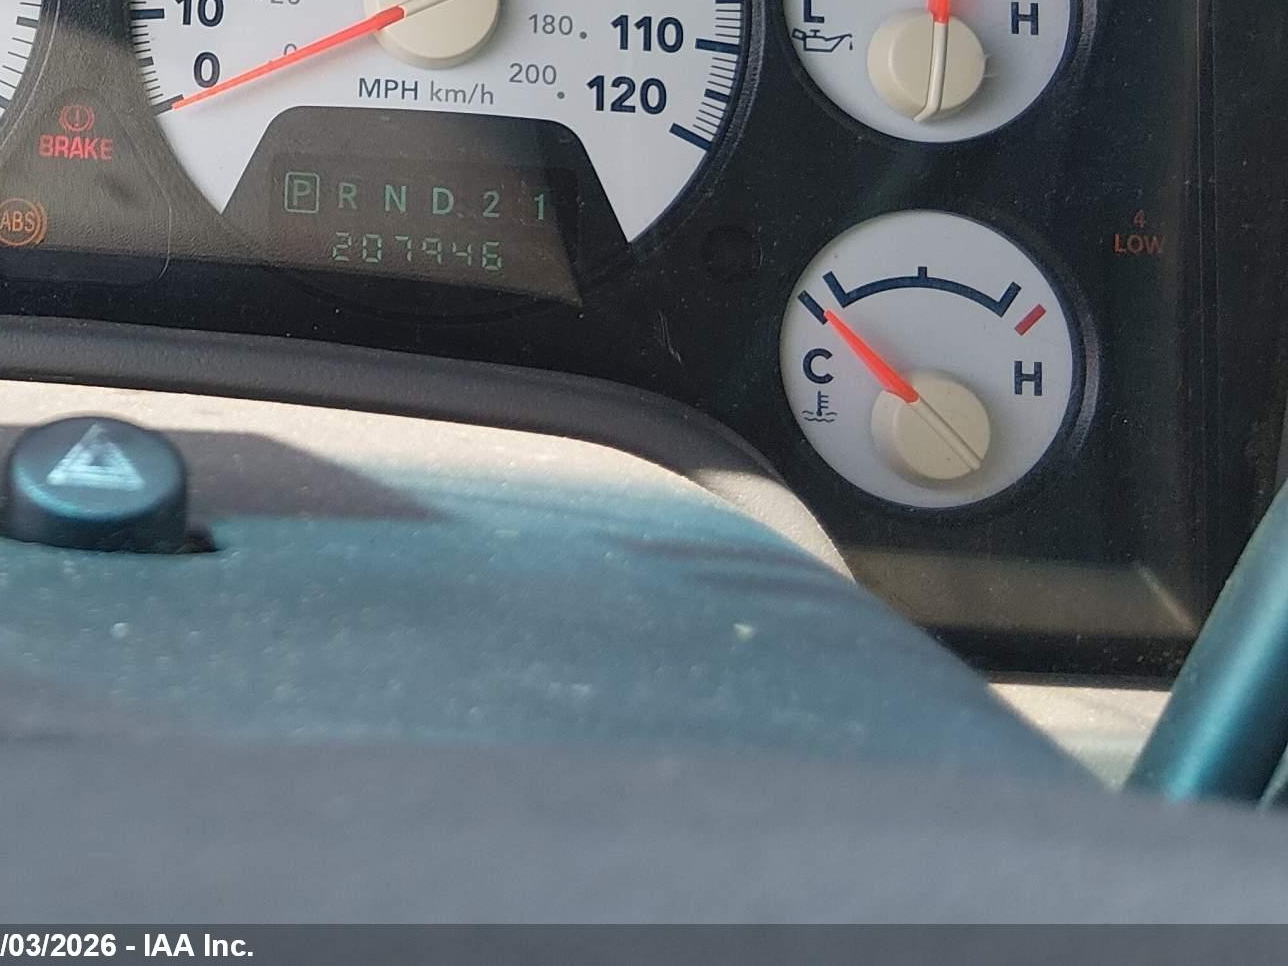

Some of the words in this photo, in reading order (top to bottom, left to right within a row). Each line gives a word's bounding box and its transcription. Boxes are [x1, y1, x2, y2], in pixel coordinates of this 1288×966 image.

[528, 13, 573, 36] 180
[610, 14, 684, 54] 110
[1010, 1, 1039, 36] H
[193, 51, 221, 89] 0
[509, 62, 557, 86] 200
[358, 77, 419, 101] MPH
[428, 80, 495, 107] km/h
[586, 74, 667, 115] 120
[39, 134, 113, 161] BRAKE
[291, 179, 312, 206] P
[337, 182, 358, 210] R
[384, 184, 407, 212] N
[432, 187, 455, 215] D
[482, 190, 500, 218] 2
[534, 193, 546, 220] 1
[331, 232, 503, 271] 207946
[1113, 233, 1167, 254] LOW
[802, 348, 835, 385] C
[1013, 360, 1043, 397] H
